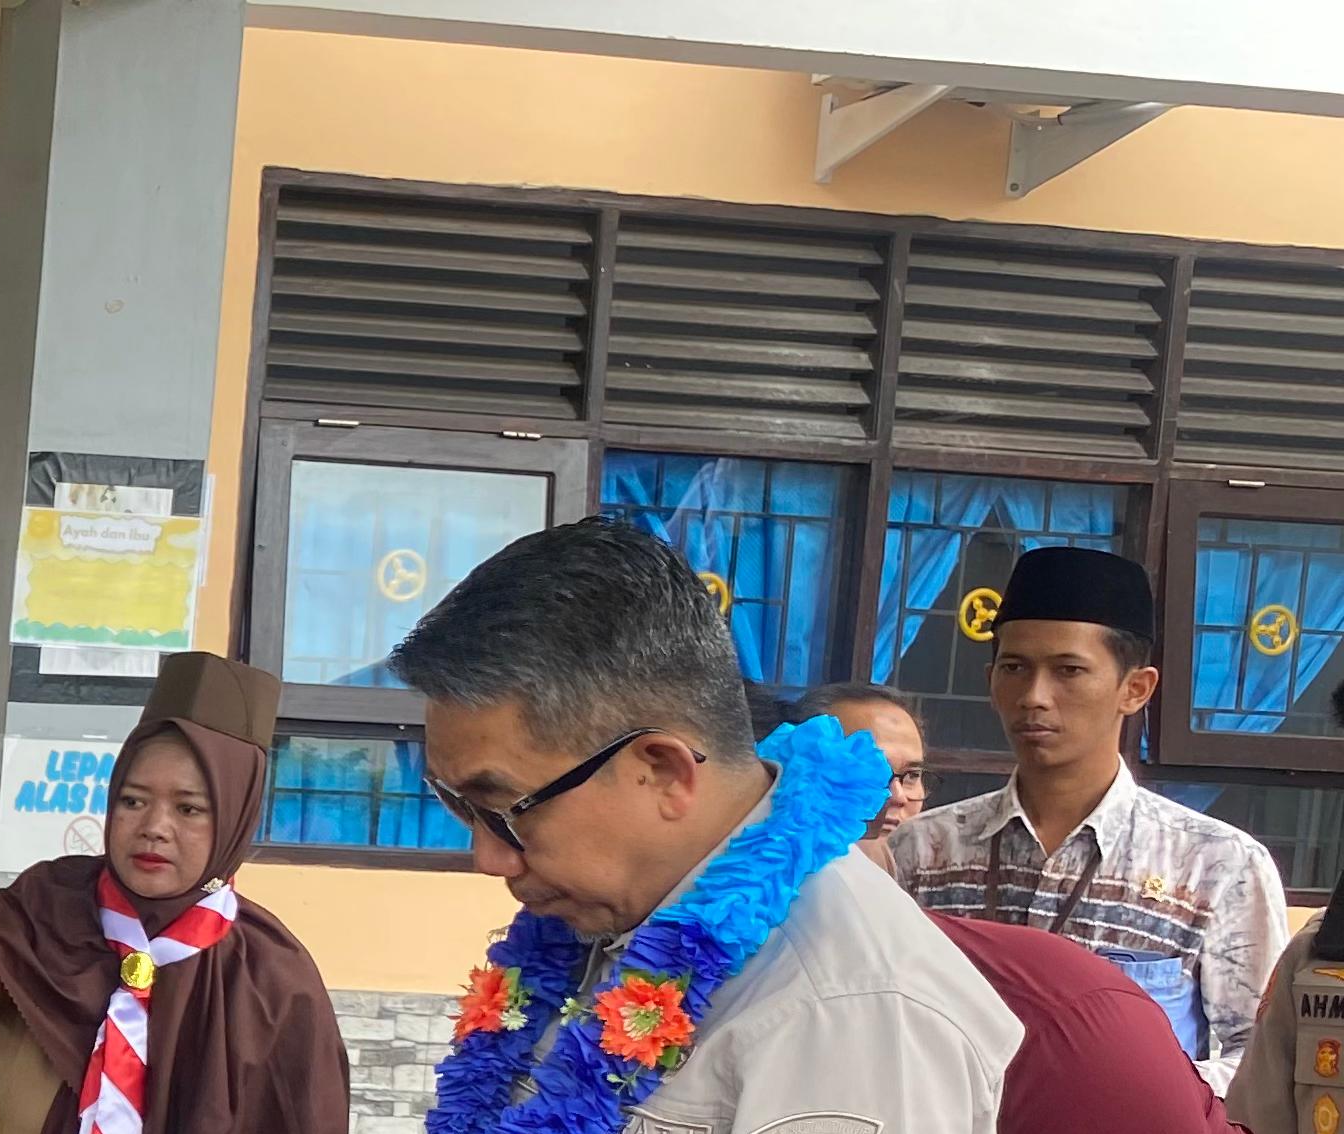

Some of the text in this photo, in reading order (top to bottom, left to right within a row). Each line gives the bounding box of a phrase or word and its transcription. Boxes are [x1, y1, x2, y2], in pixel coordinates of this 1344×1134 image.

[63, 524, 98, 540] Ayah
[101, 527, 126, 540] dan
[45, 750, 116, 783] LEPA
[15, 779, 90, 814] ALAS
[1301, 993, 1344, 1018] AHM
